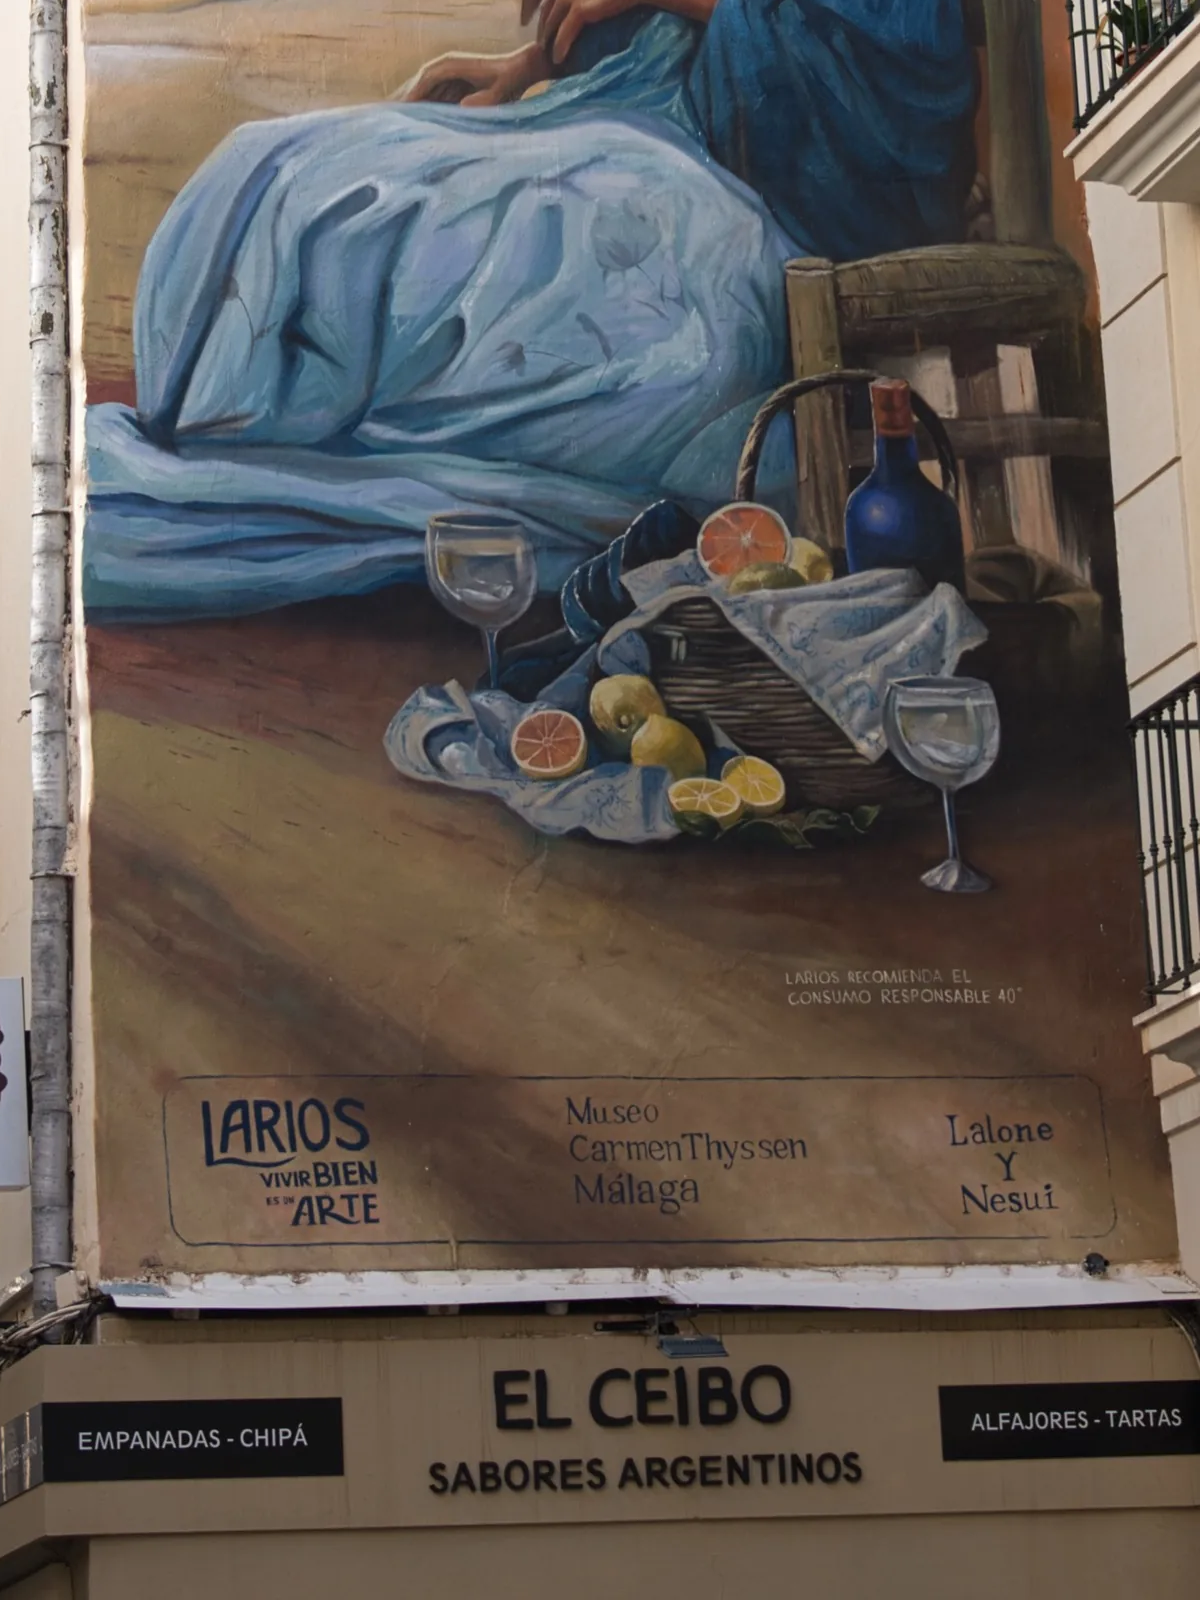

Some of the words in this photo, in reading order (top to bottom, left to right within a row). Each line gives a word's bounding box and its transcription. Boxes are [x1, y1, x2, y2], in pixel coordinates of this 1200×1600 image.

[785, 970, 840, 985] LARIOS
[847, 968, 943, 984] RECOMIENDA
[952, 968, 972, 984] EL
[788, 989, 872, 1006] CONSUMO
[880, 988, 992, 1005] RESPONSABLE
[565, 1096, 659, 1125] Museo
[202, 1097, 370, 1168] LARIOS
[944, 1112, 1055, 1146] Lalone
[259, 1169, 311, 1188] VIVIR
[312, 1160, 379, 1188] BIEN
[994, 1150, 1018, 1181] Y
[573, 1172, 701, 1215] Málaga
[960, 1183, 1060, 1215] Nesui
[266, 1195, 280, 1206] ES
[290, 1192, 380, 1227] ARTE
[493, 1368, 573, 1431] EL
[588, 1364, 792, 1427] CEIBO
[971, 1410, 1089, 1431] ALFAJORES
[1105, 1408, 1183, 1428] TARTAS
[78, 1429, 221, 1451] EMPANADAS
[239, 1422, 309, 1448] CHIPÁ
[428, 1457, 606, 1495] SABORES
[617, 1451, 864, 1490] ARGENTINOS
